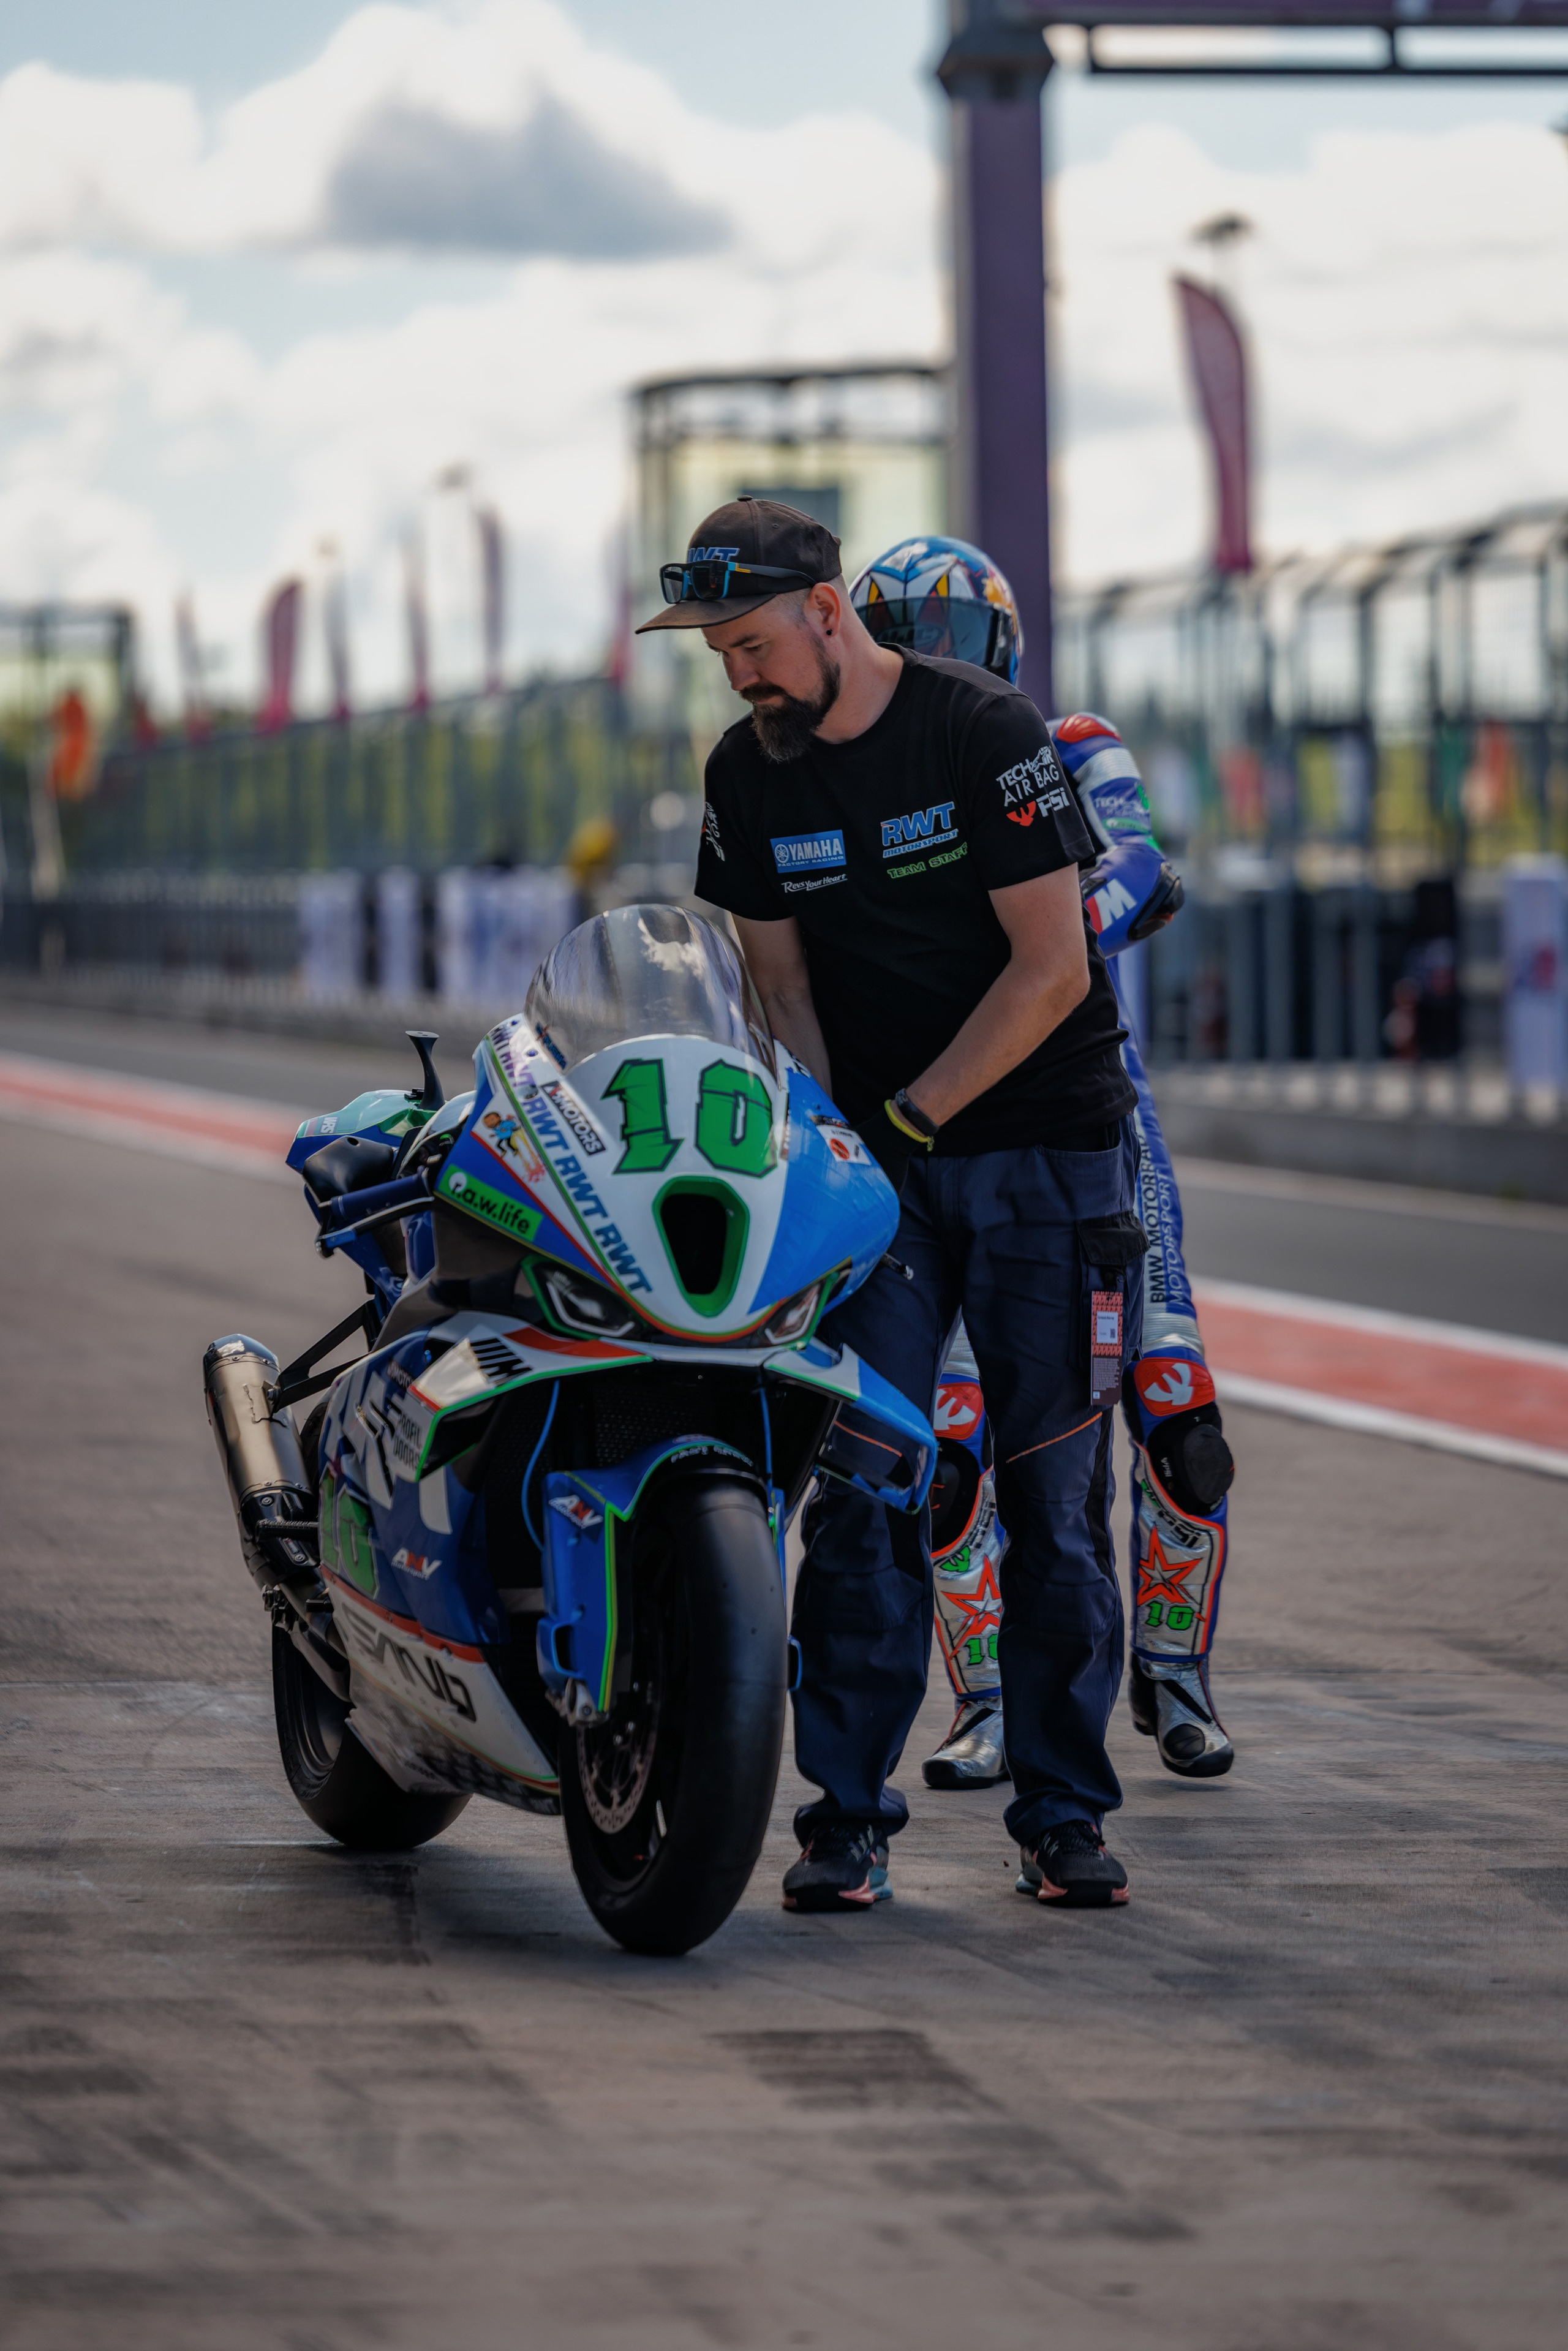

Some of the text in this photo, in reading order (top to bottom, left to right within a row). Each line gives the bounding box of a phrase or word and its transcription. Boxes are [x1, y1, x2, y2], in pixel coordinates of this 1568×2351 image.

[686, 546, 740, 562] WT
[1004, 764, 1059, 807] AIR BAG
[880, 801, 956, 846] RWT
[883, 828, 959, 858] MOTORSPORT
[788, 838, 843, 861] YAMAHA
[887, 842, 968, 879] TEAM STAFF
[599, 1057, 777, 1178] 10
[451, 1182, 530, 1234] r.a.w.life
[522, 1096, 570, 1150] RWT
[555, 1155, 609, 1218] RWT
[595, 1223, 652, 1292] RWT
[1139, 1134, 1165, 1304] BMW MOTORRAD
[1156, 1169, 1184, 1305] MOTORSPORT
[1145, 1600, 1194, 1631] 10
